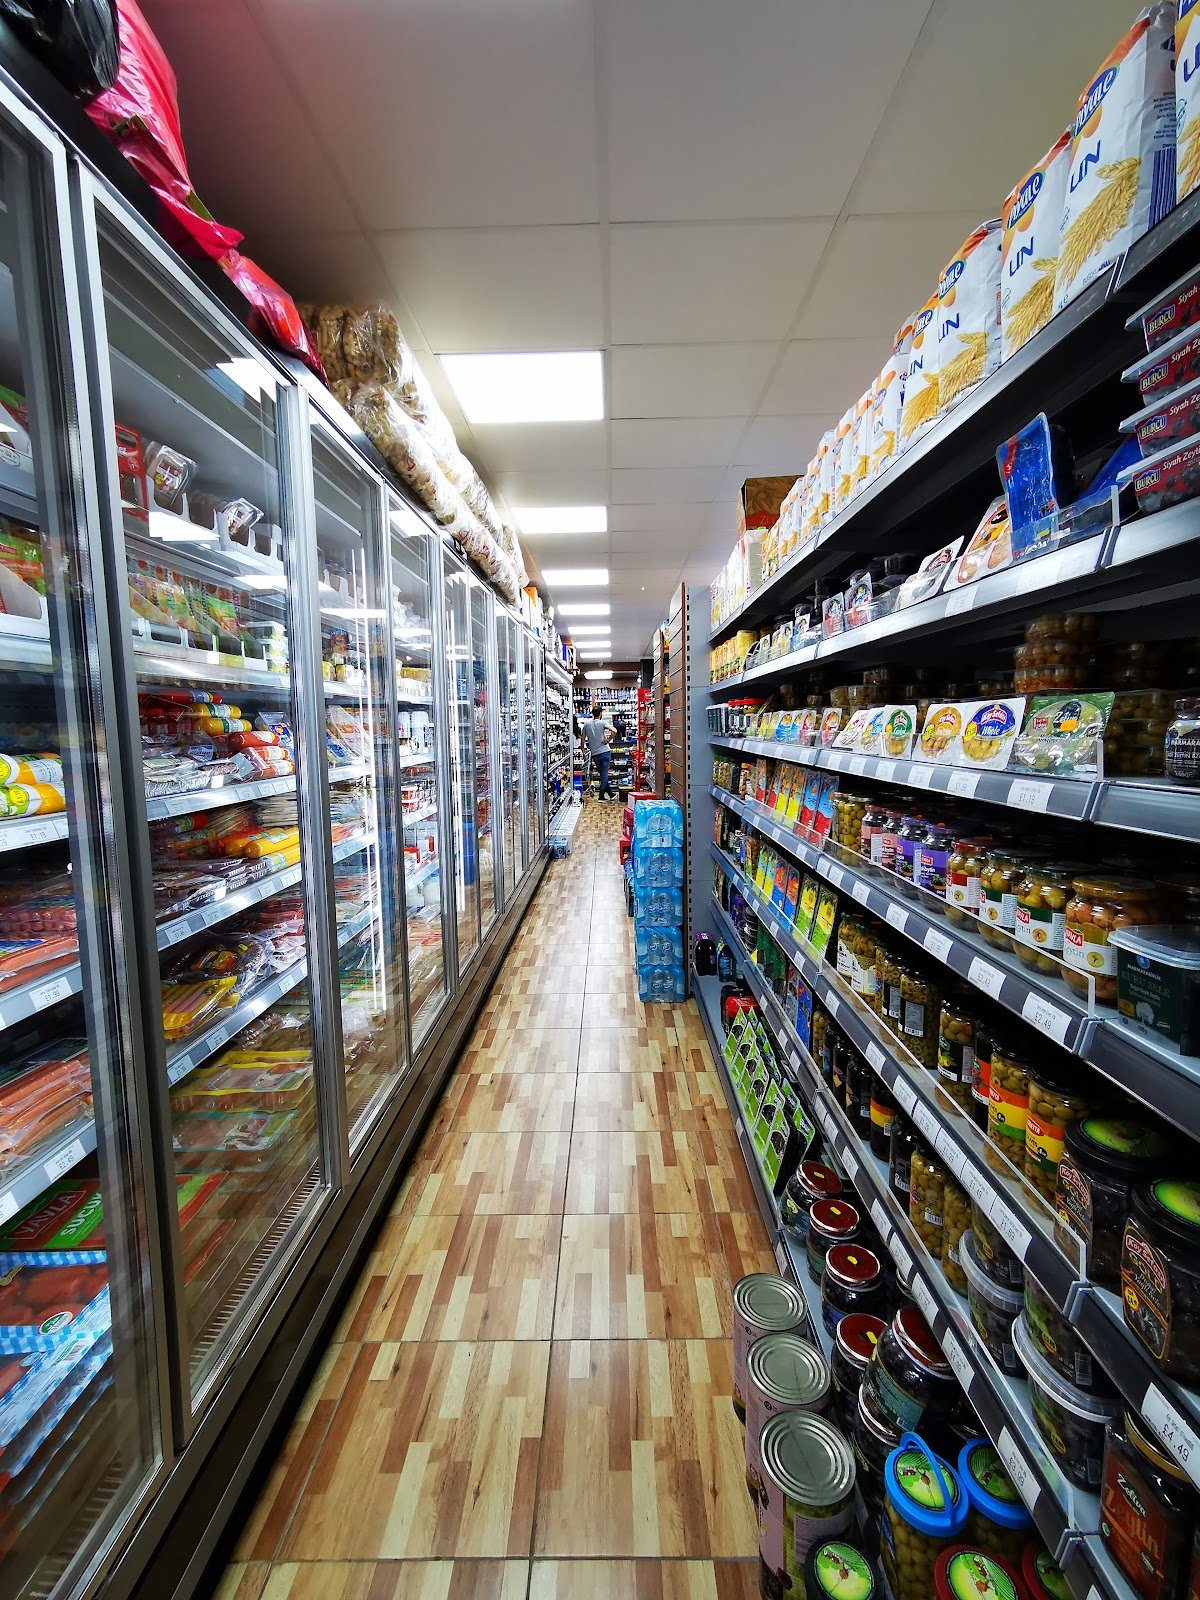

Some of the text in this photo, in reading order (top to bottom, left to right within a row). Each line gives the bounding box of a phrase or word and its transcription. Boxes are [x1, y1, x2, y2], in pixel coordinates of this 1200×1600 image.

[1178, 285, 1198, 304] Siyah
[1149, 309, 1173, 332] BURCU
[1171, 344, 1191, 363] Siyah
[1142, 368, 1166, 390] BURCU
[1169, 397, 1189, 415] Siyah
[1141, 418, 1164, 437] BURCU
[1162, 456, 1181, 471] Siyah
[1136, 471, 1158, 490] BURCU
[15, 1194, 77, 1235] YAYLA
[1163, 1423, 1190, 1462] £4.49
